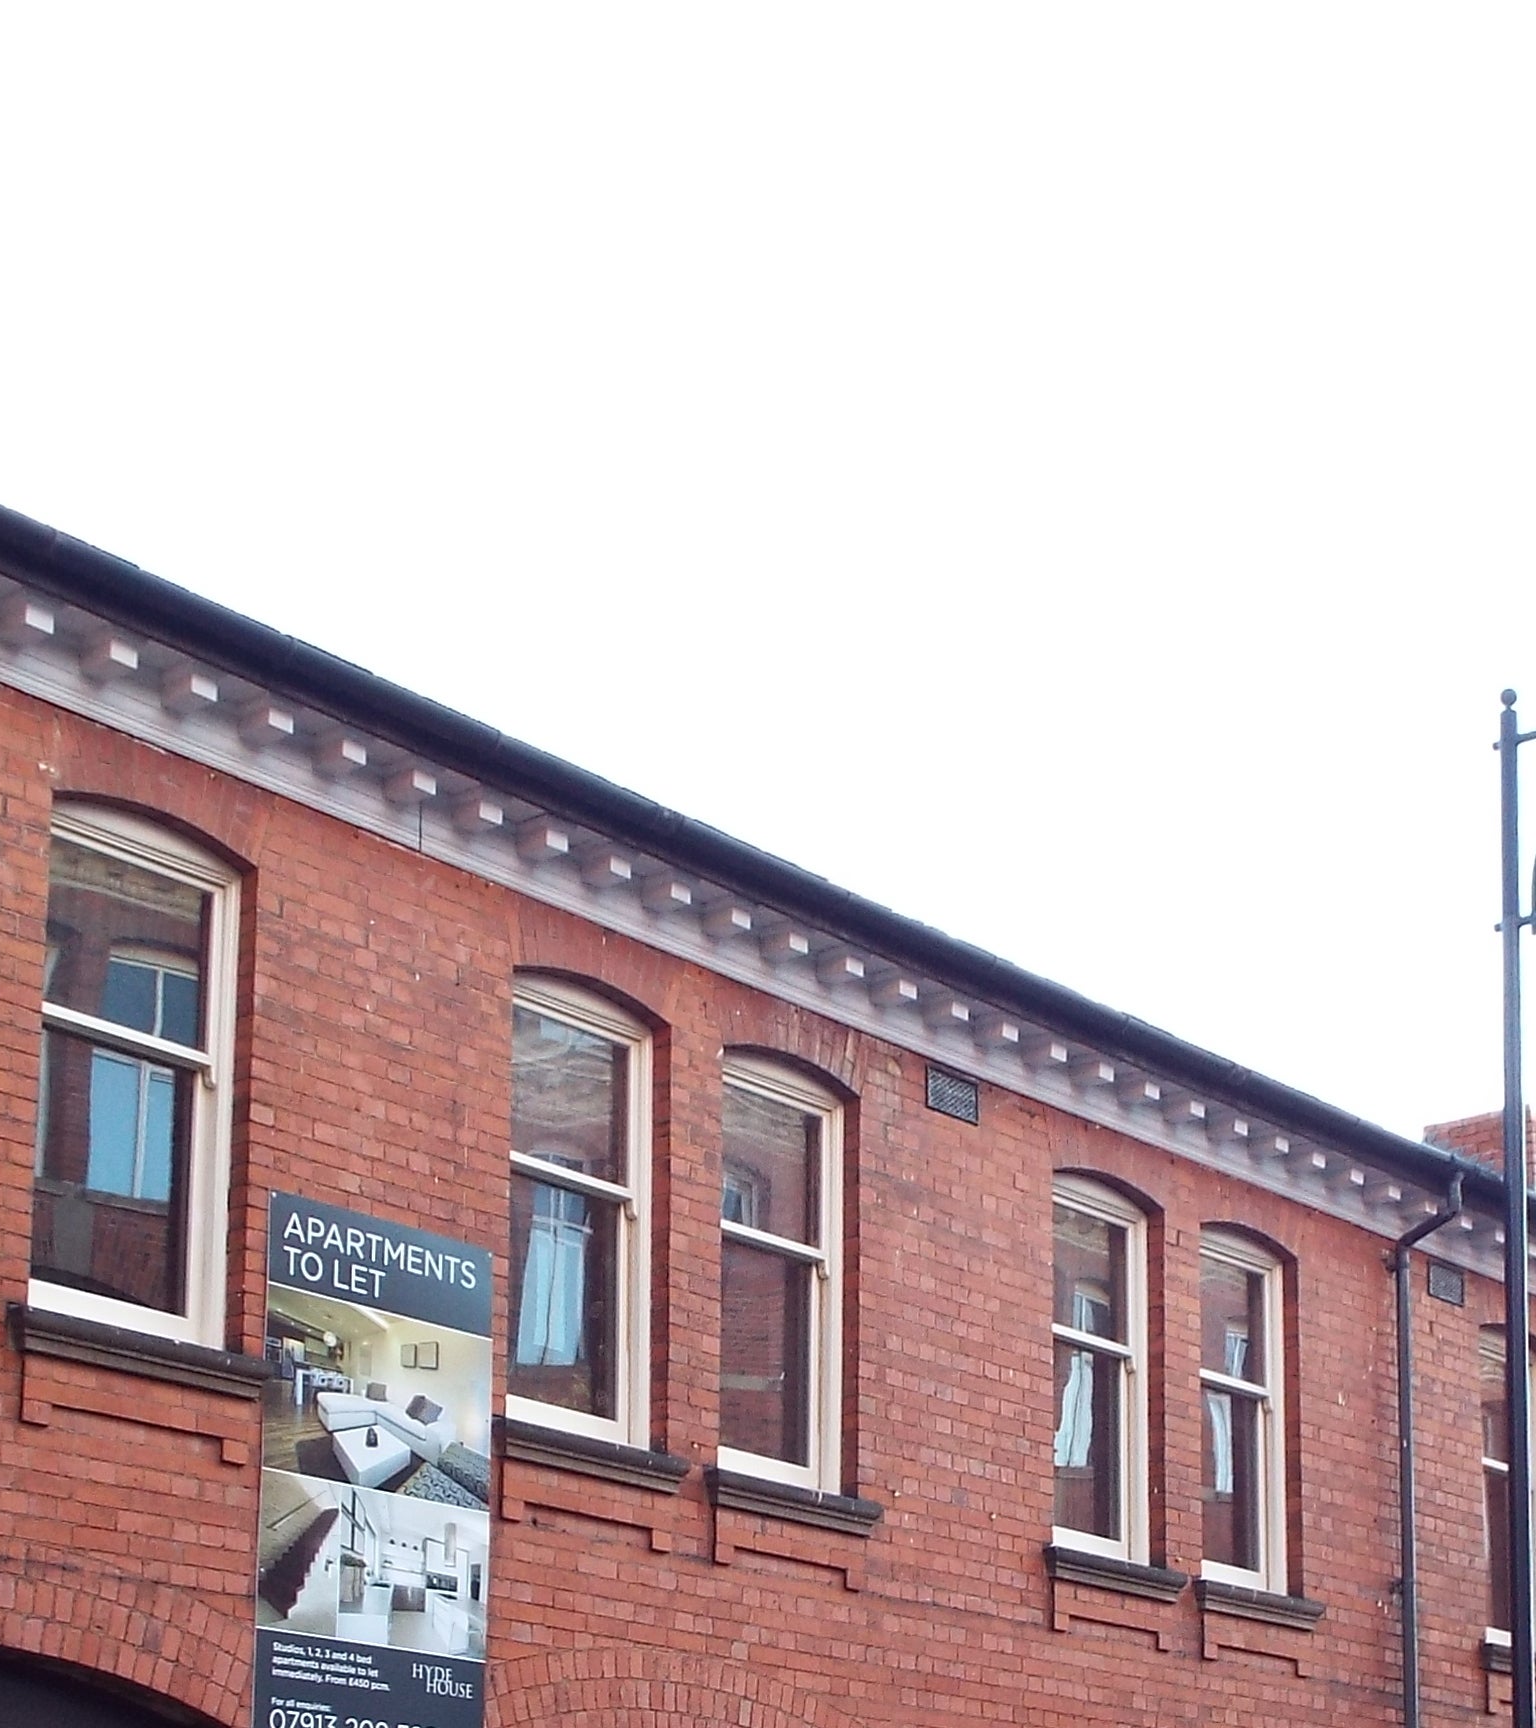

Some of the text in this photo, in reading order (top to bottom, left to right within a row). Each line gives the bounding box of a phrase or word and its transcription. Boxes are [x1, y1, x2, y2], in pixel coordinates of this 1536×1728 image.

[282, 1211, 478, 1290] APARTMENTS
[282, 1245, 387, 1299] TO LET
[324, 1649, 331, 1659] 3
[348, 1652, 355, 1662] 4
[412, 1663, 453, 1682] HYDE
[426, 1680, 474, 1700] HOUSE
